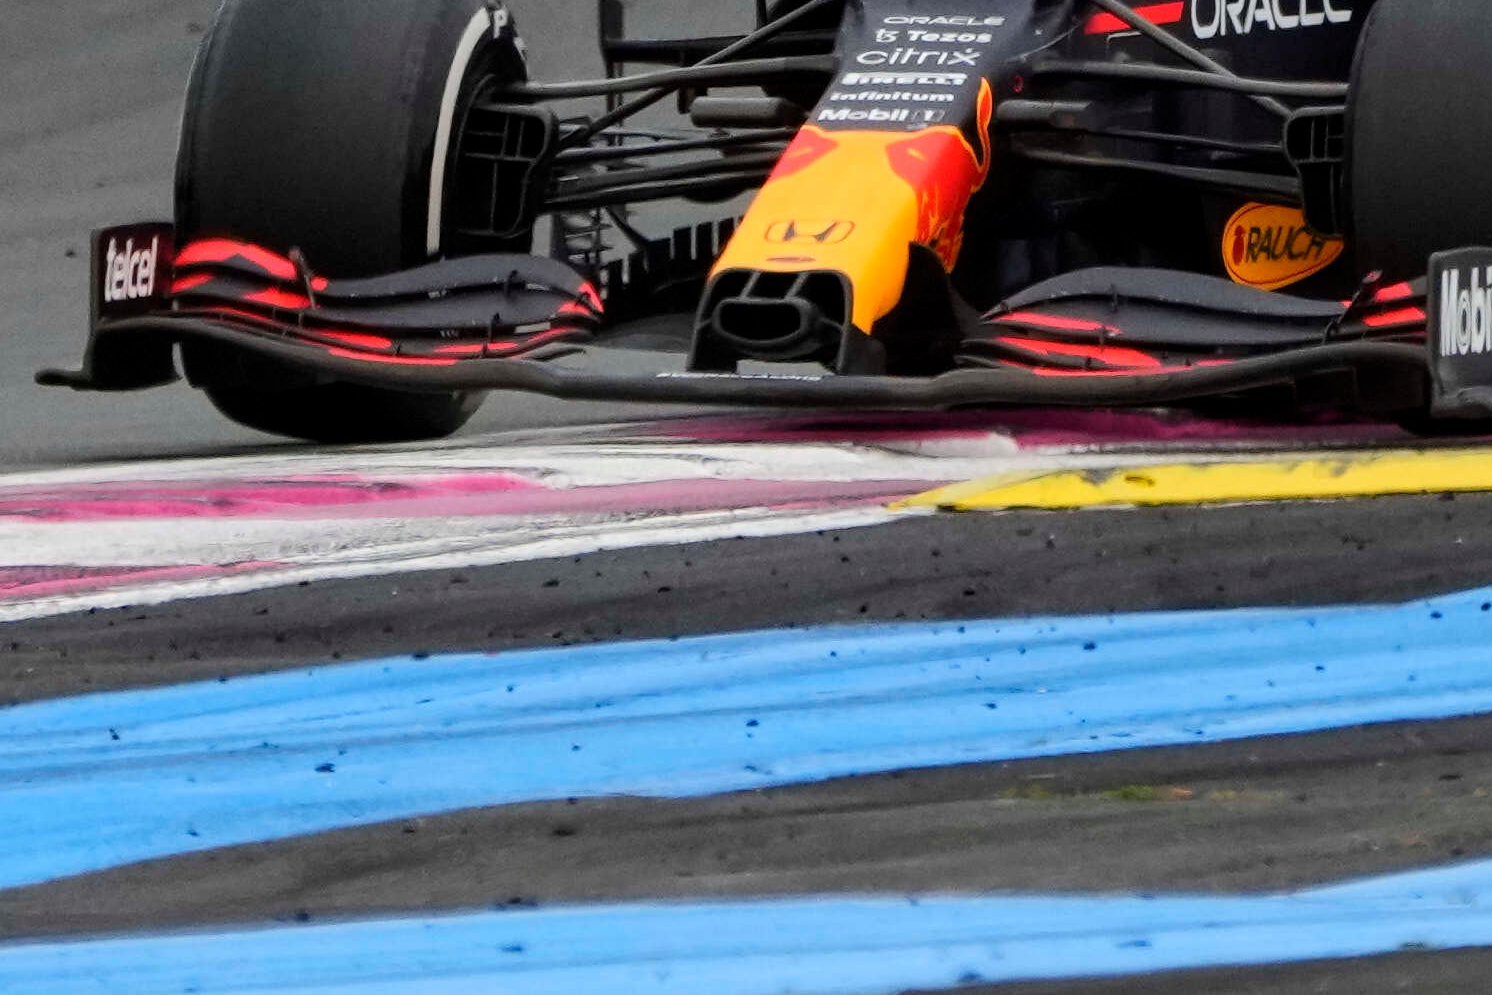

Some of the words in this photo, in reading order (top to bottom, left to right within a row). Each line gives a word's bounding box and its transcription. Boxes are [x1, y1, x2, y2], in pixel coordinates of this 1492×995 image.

[883, 15, 1006, 26] ORACLE
[905, 30, 993, 43] Tezos
[856, 47, 982, 66] citrix
[841, 72, 969, 86] PIRELLI
[829, 90, 955, 102] infinitum
[817, 107, 910, 122] Mobil
[1245, 225, 1326, 263] RAUCH
[104, 235, 158, 302] telcel
